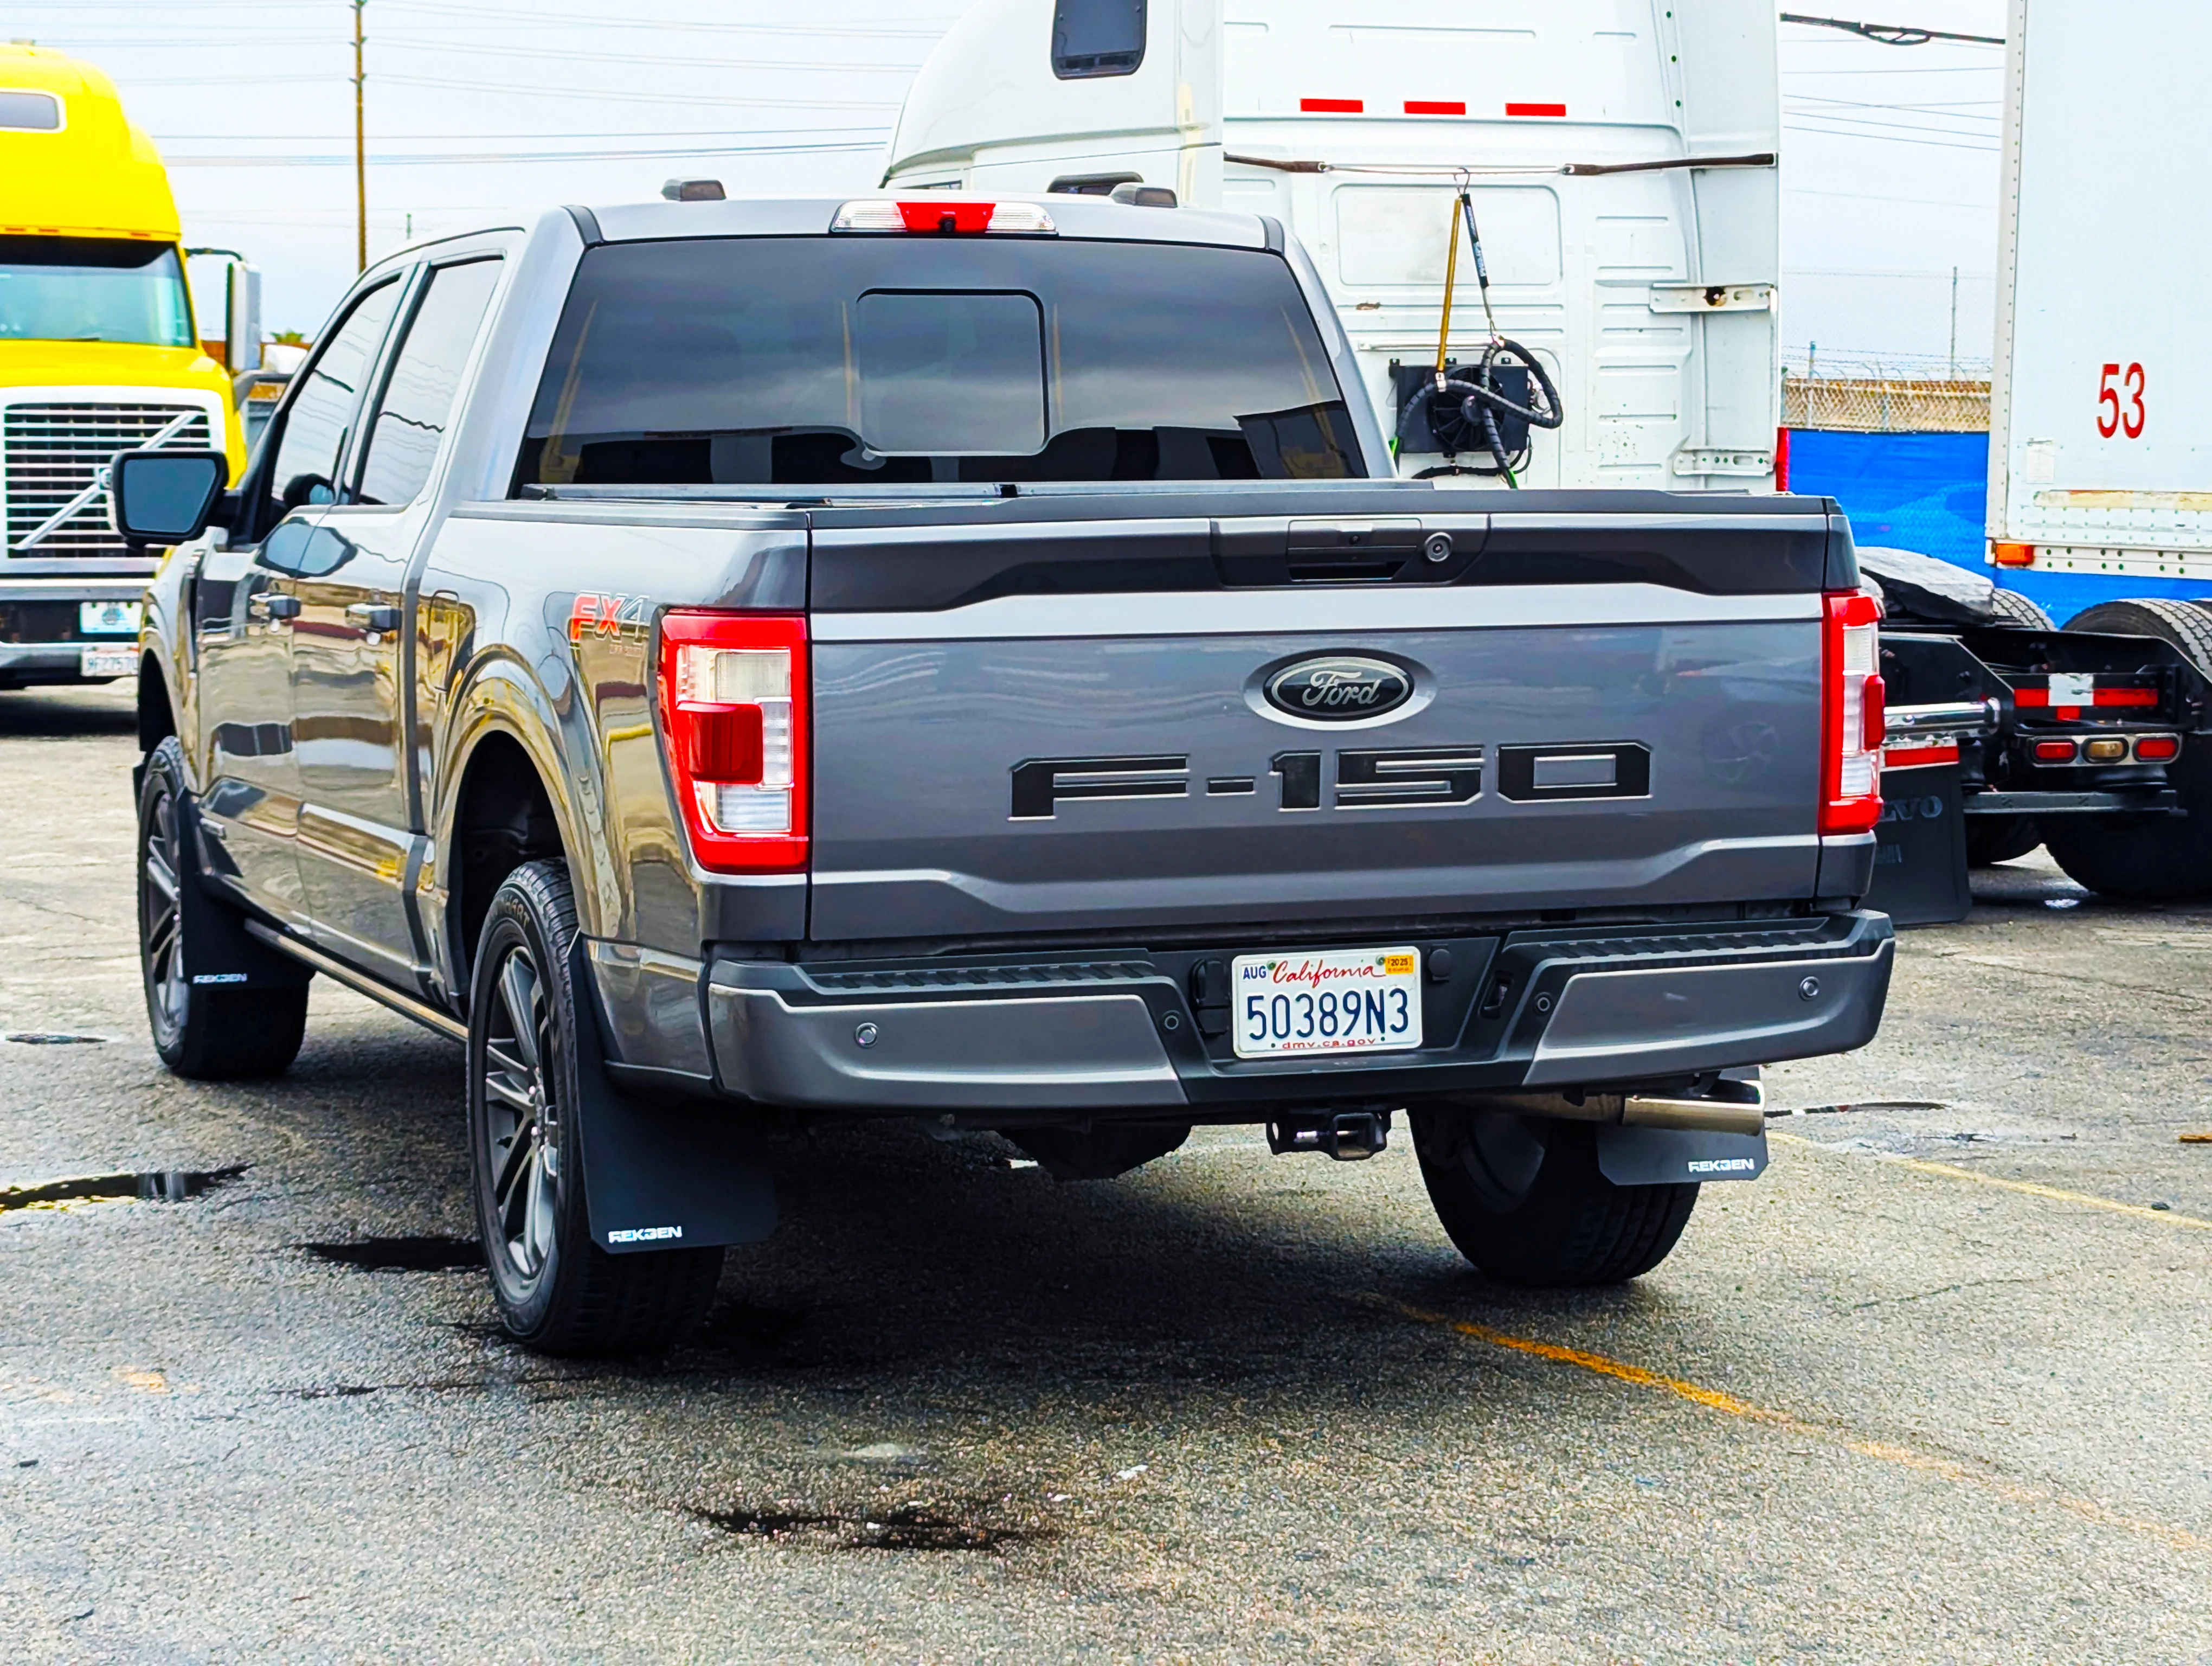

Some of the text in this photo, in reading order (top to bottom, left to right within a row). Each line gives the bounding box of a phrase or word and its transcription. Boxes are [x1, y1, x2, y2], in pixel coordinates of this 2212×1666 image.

[2096, 362, 2145, 439] 53
[569, 590, 650, 646] FX4
[1302, 670, 1380, 706] Ford
[1008, 740, 1654, 821] F-150
[1879, 796, 1943, 822] LVO
[1243, 965, 1266, 980] AUG
[1273, 959, 1386, 989] California
[1247, 988, 1409, 1040] 50389N3
[1282, 1037, 1376, 1049] dmv.ca.gov
